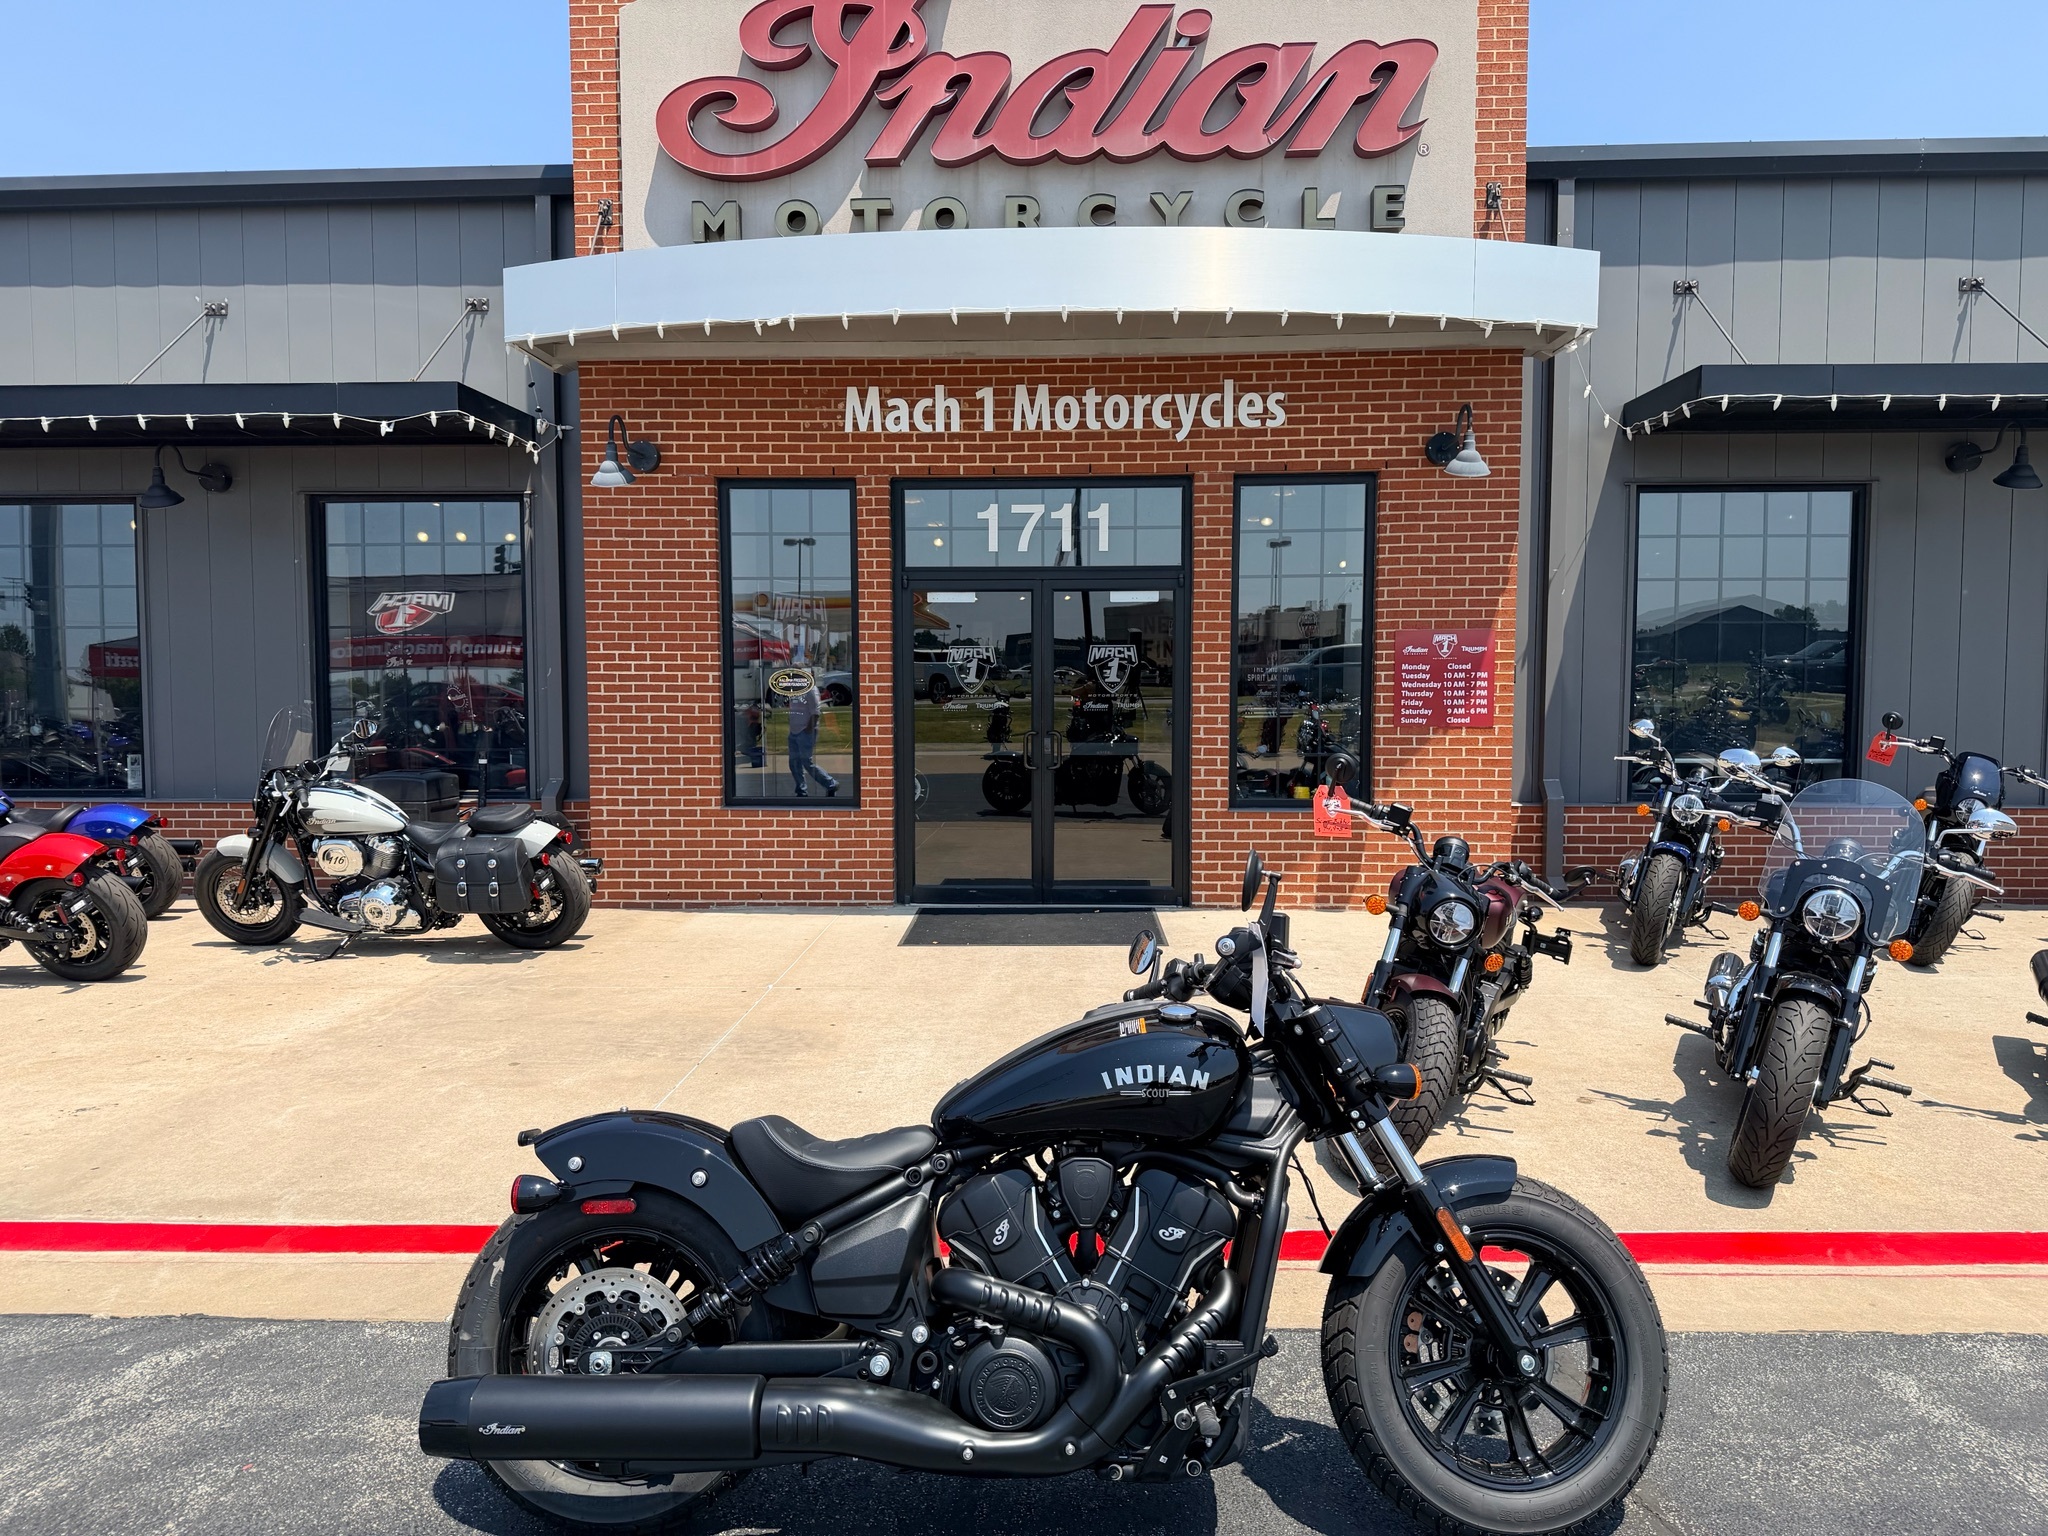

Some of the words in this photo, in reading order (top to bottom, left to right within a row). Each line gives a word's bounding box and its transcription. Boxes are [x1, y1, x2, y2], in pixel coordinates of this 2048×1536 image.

[656, 0, 1438, 182] Indian
[691, 184, 1406, 243] MOTORCYCLE
[844, 384, 961, 433] Mach
[975, 387, 994, 432] 1
[1012, 379, 1287, 443] Motorcycles
[977, 502, 1110, 552] 1711
[950, 648, 994, 663] MACH
[1090, 647, 1136, 663] MACH
[964, 659, 980, 683] 1
[1105, 658, 1120, 683] 1
[1402, 681, 1441, 689] Wednesday
[1401, 690, 1434, 698] Thursday
[943, 701, 968, 709] Indian
[1083, 701, 1109, 709] Indian
[1401, 708, 1432, 716] Saturday
[1401, 717, 1427, 725] Sunday
[1101, 1064, 1210, 1090] INDIAN
[1141, 1088, 1170, 1098] SCOUT
[482, 1422, 523, 1436] Indian
